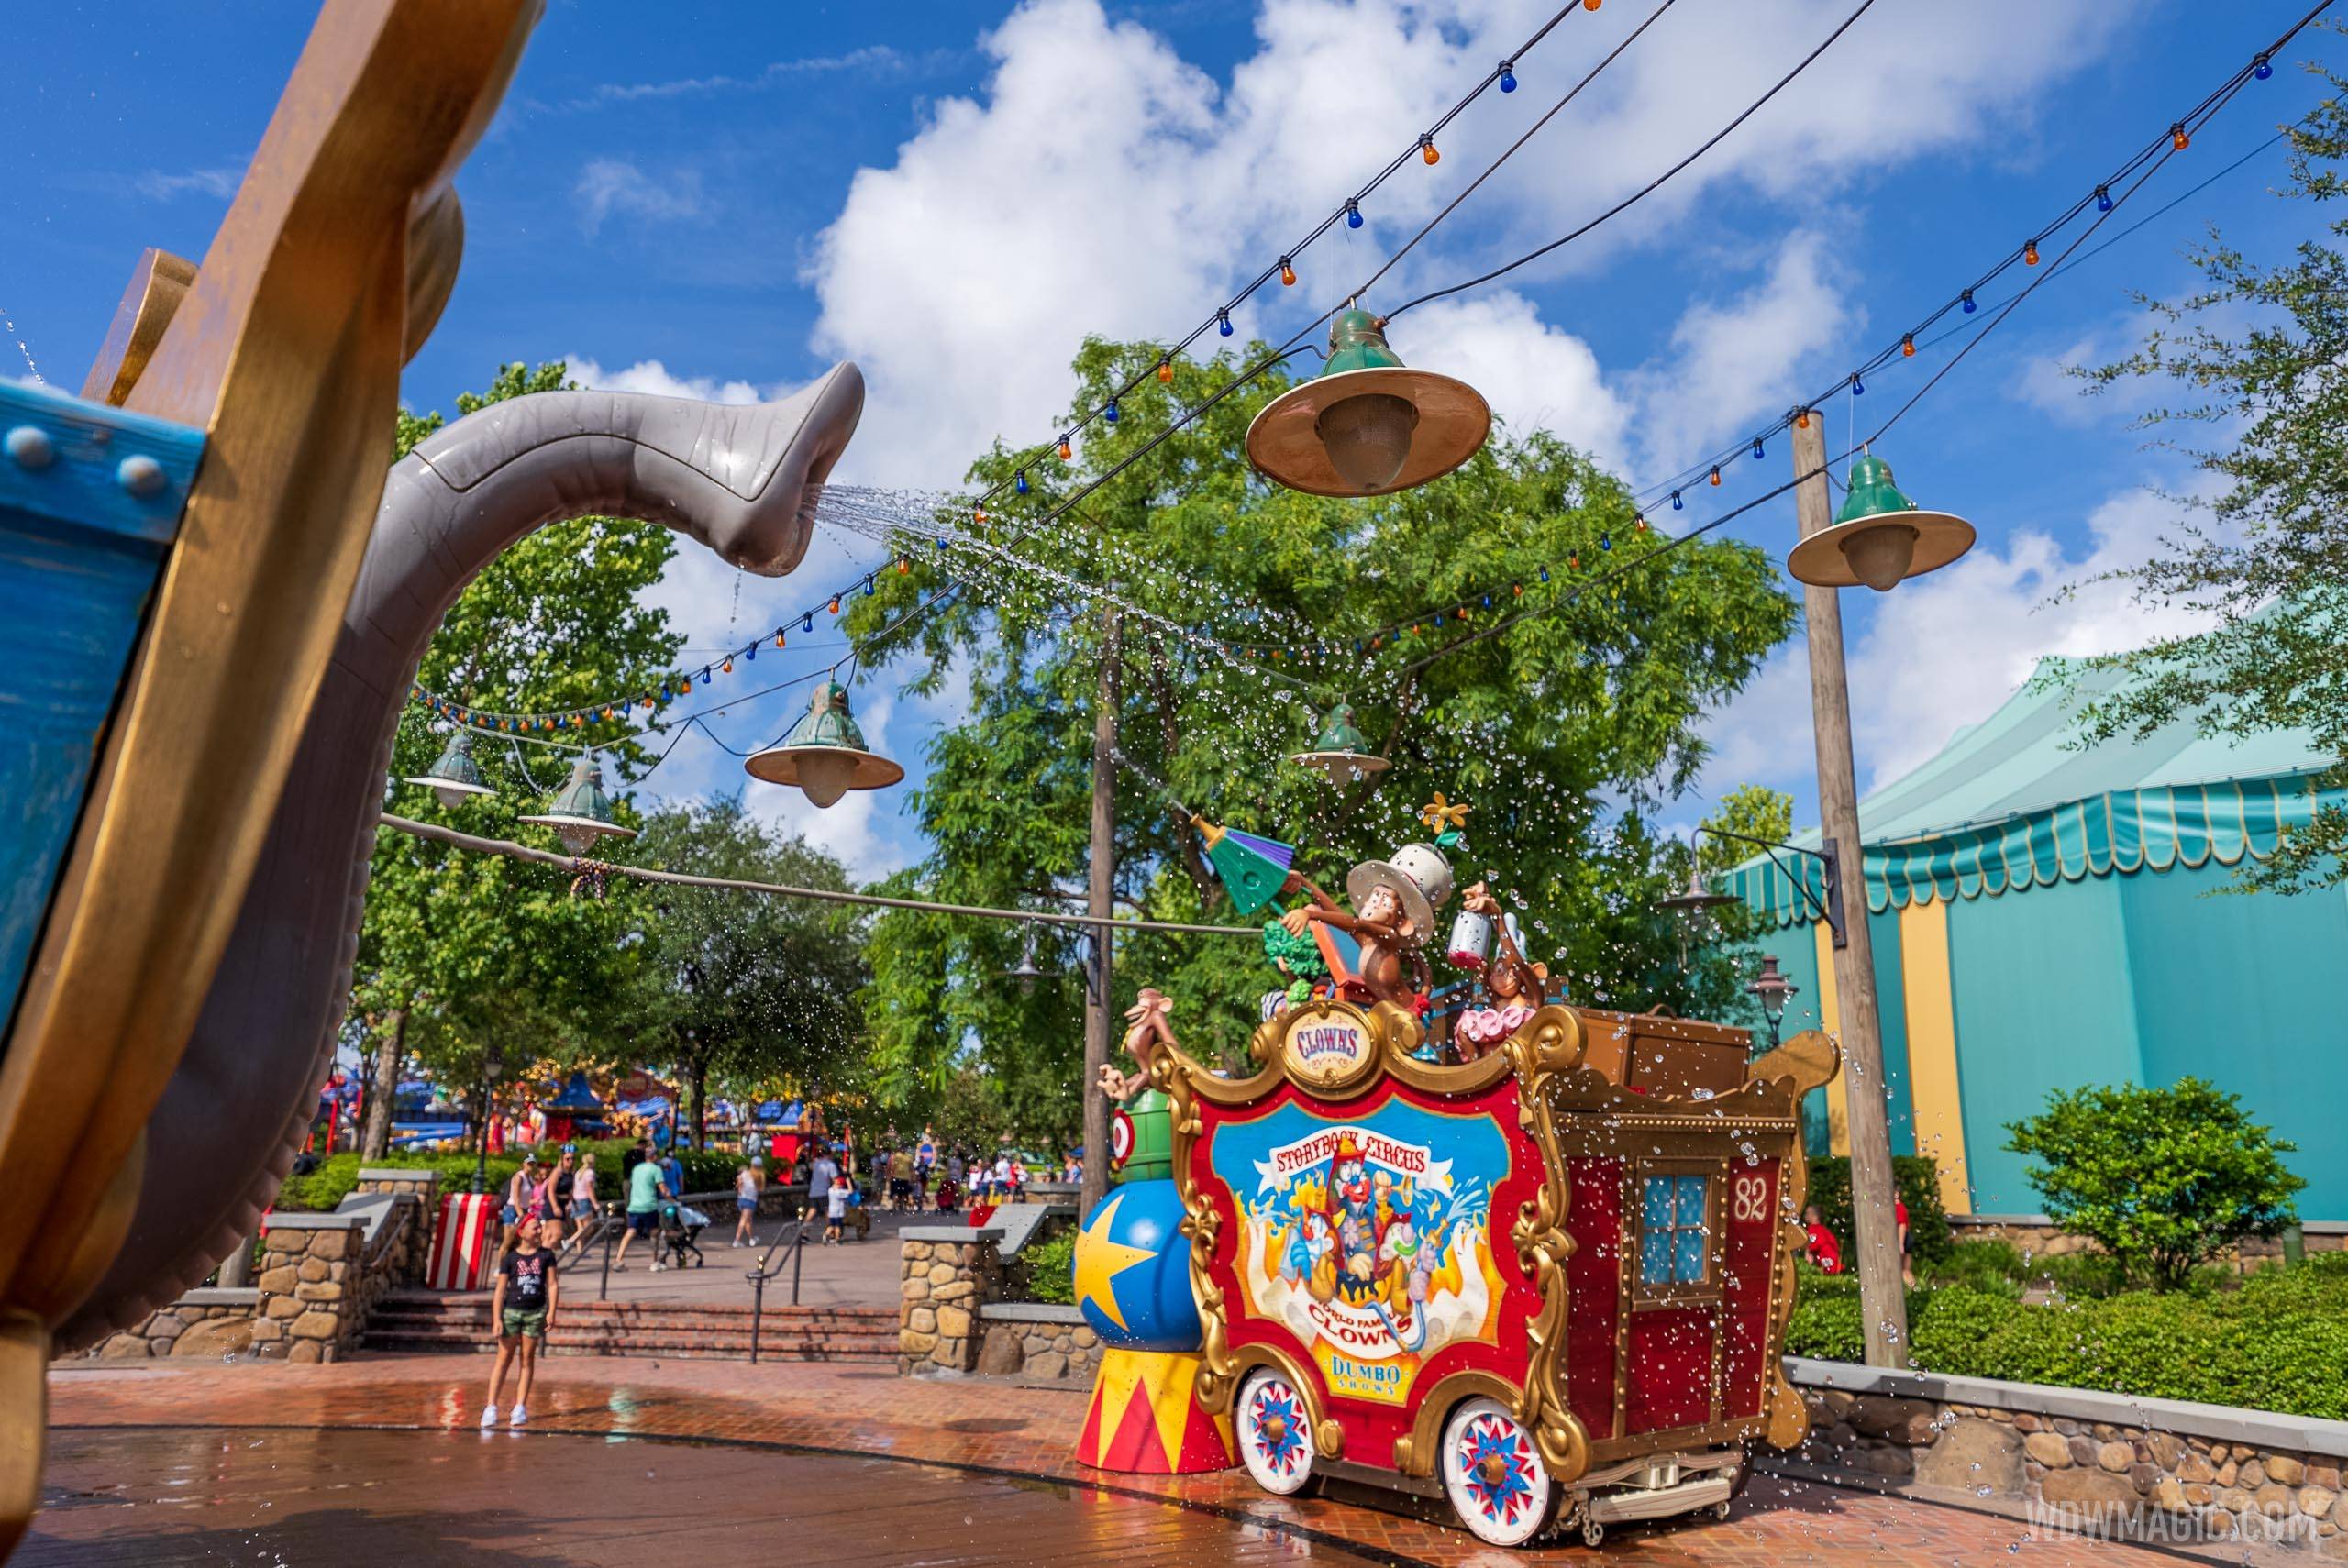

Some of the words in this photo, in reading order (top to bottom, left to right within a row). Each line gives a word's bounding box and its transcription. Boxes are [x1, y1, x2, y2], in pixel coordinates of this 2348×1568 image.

[1297, 1028, 1358, 1060] CLOWNS
[1366, 1135, 1425, 1173] CIRCUS
[1734, 1177, 1767, 1220] 82
[1308, 1303, 1412, 1346] CLOWNS
[1320, 1301, 1355, 1326] ORLD
[1332, 1354, 1401, 1385] DUMBO
[1338, 1378, 1394, 1395] SHOWS
